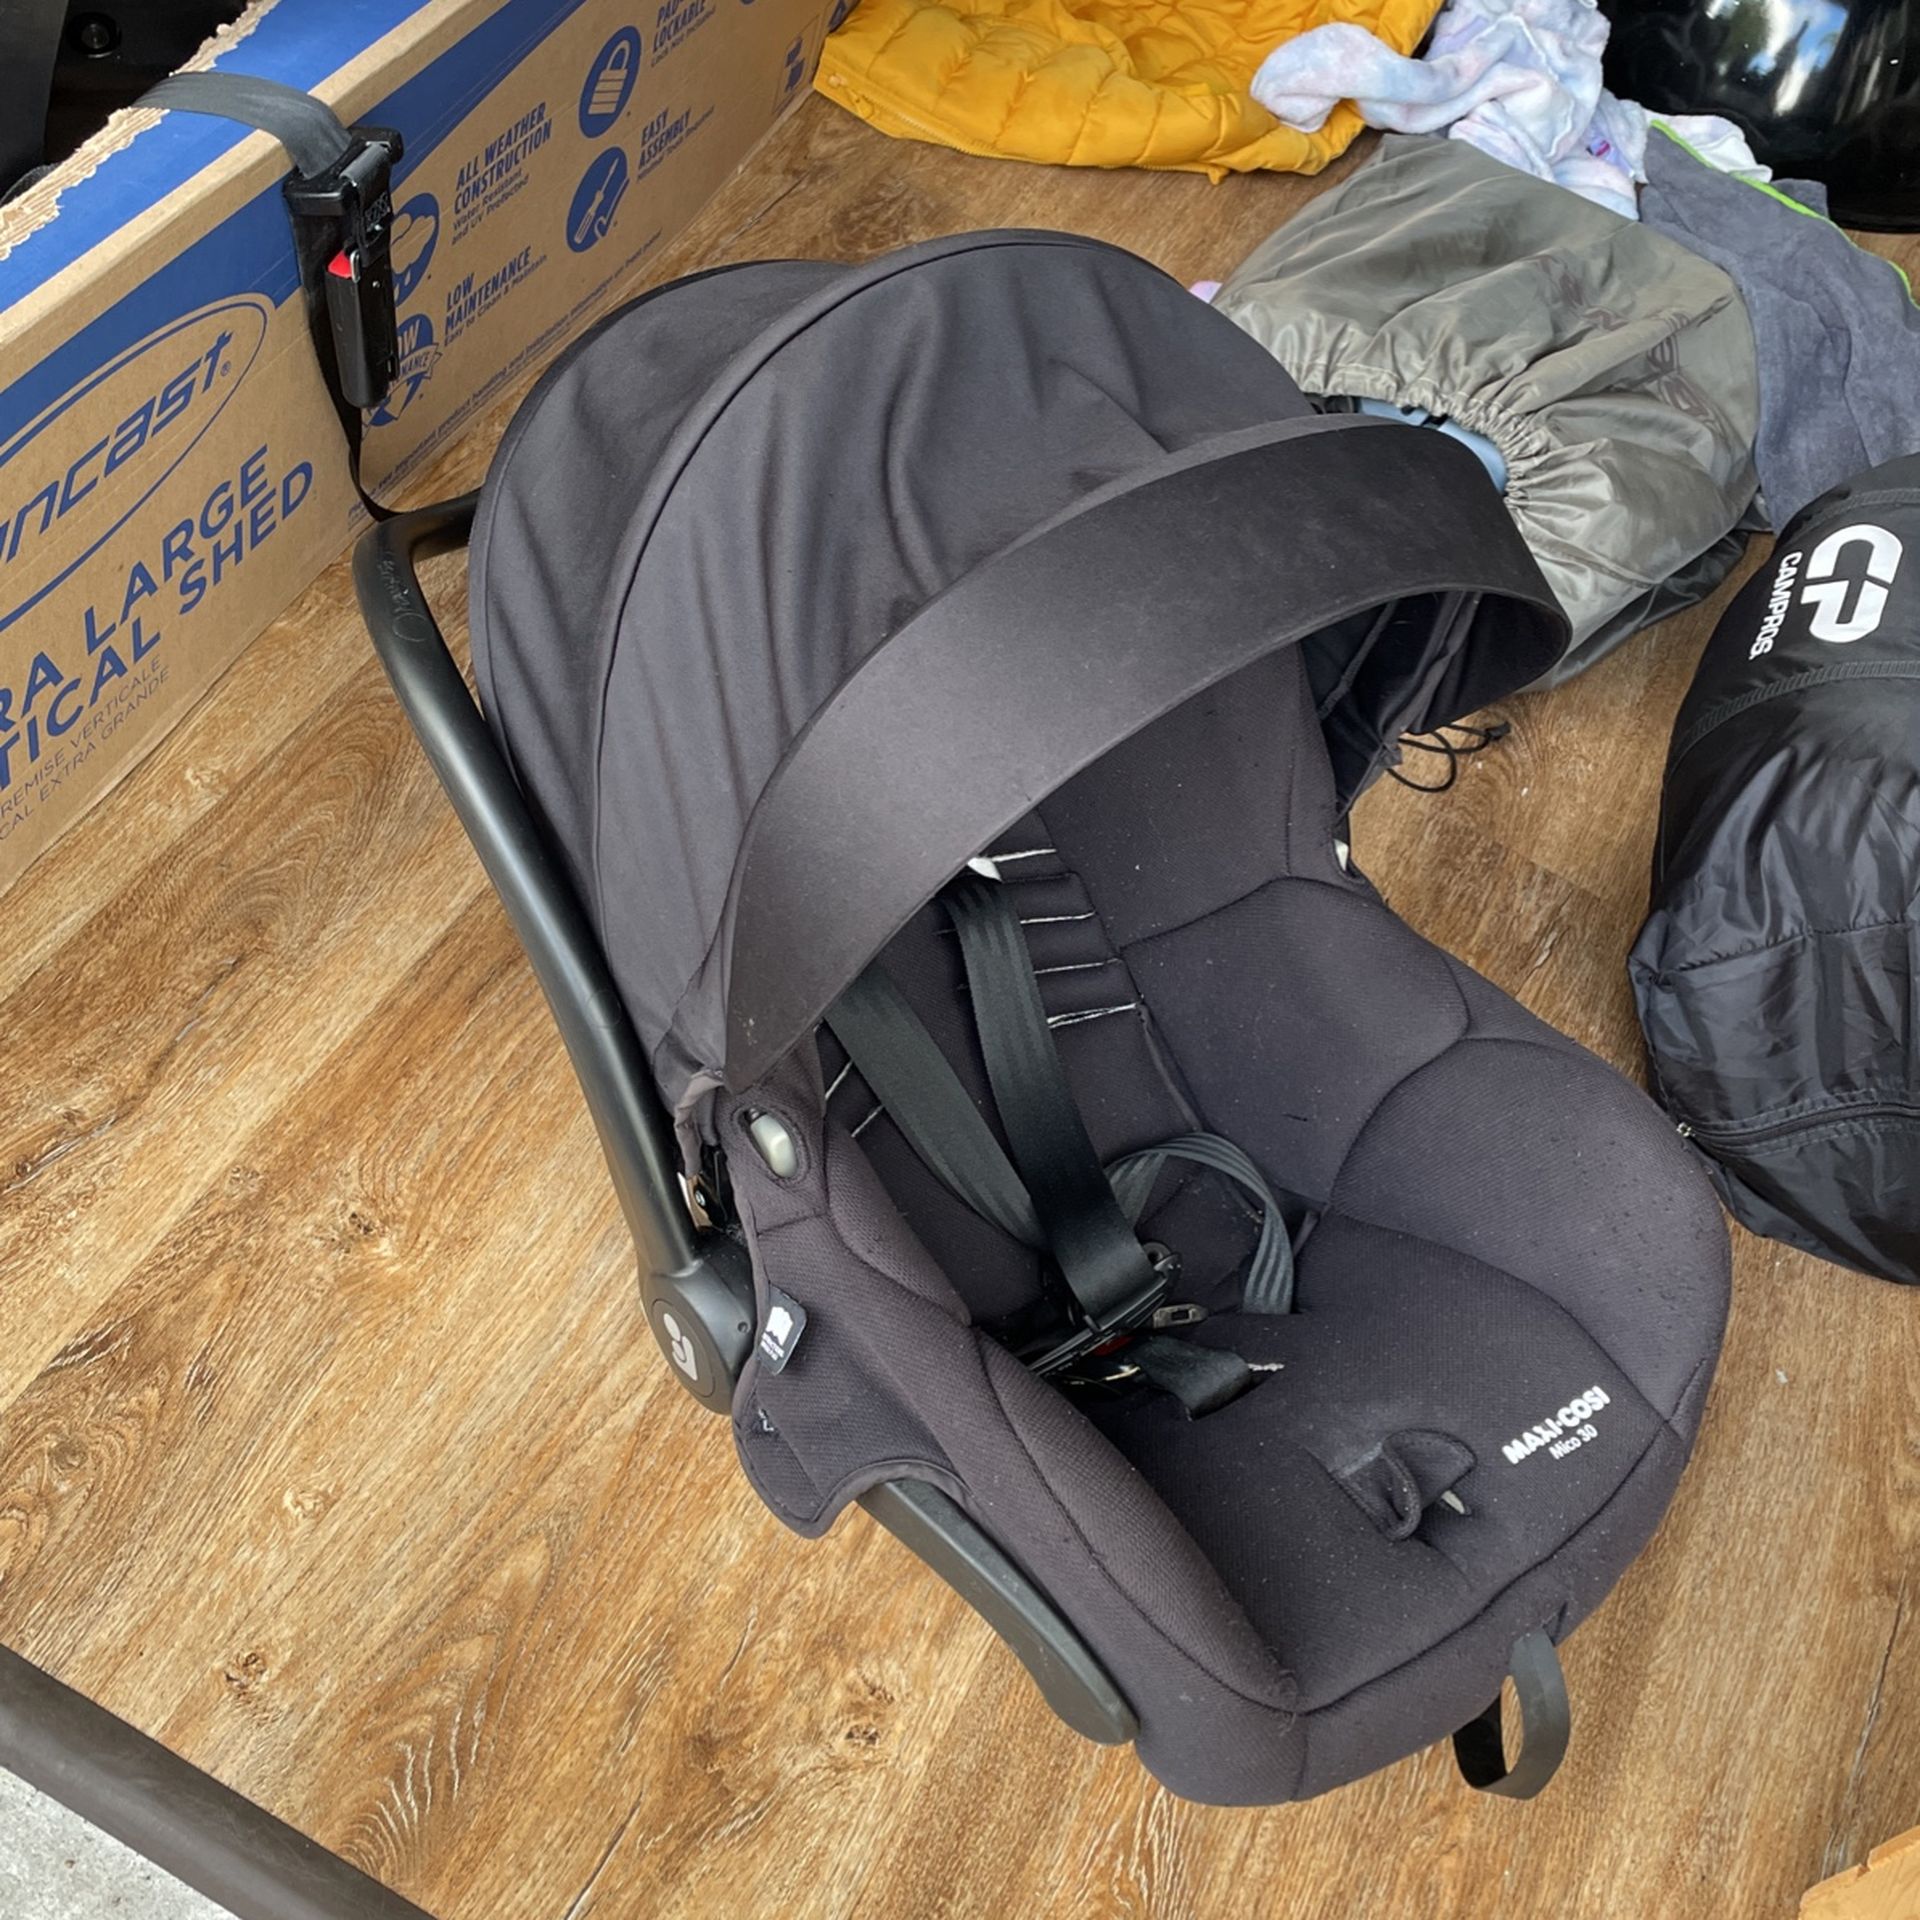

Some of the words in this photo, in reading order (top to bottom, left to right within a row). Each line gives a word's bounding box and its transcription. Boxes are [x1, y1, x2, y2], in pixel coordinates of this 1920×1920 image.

[454, 118, 552, 215] CONSTRUCTION
[456, 155, 479, 191] ALL
[485, 101, 546, 166] WEATHER
[638, 107, 692, 170] ASSEMBLY
[641, 107, 669, 149] EASY
[445, 245, 531, 336] MAINTENANCE
[446, 271, 475, 312] LOW
[84, 443, 268, 656] LARGE
[178, 461, 313, 616] SHED
[39, 740, 96, 802] EXTRA
[101, 665, 169, 742] GRANDE
[69, 653, 161, 749] VERTICALE
[1548, 1436, 1582, 1460] Mico
[1576, 1423, 1598, 1442] 30
